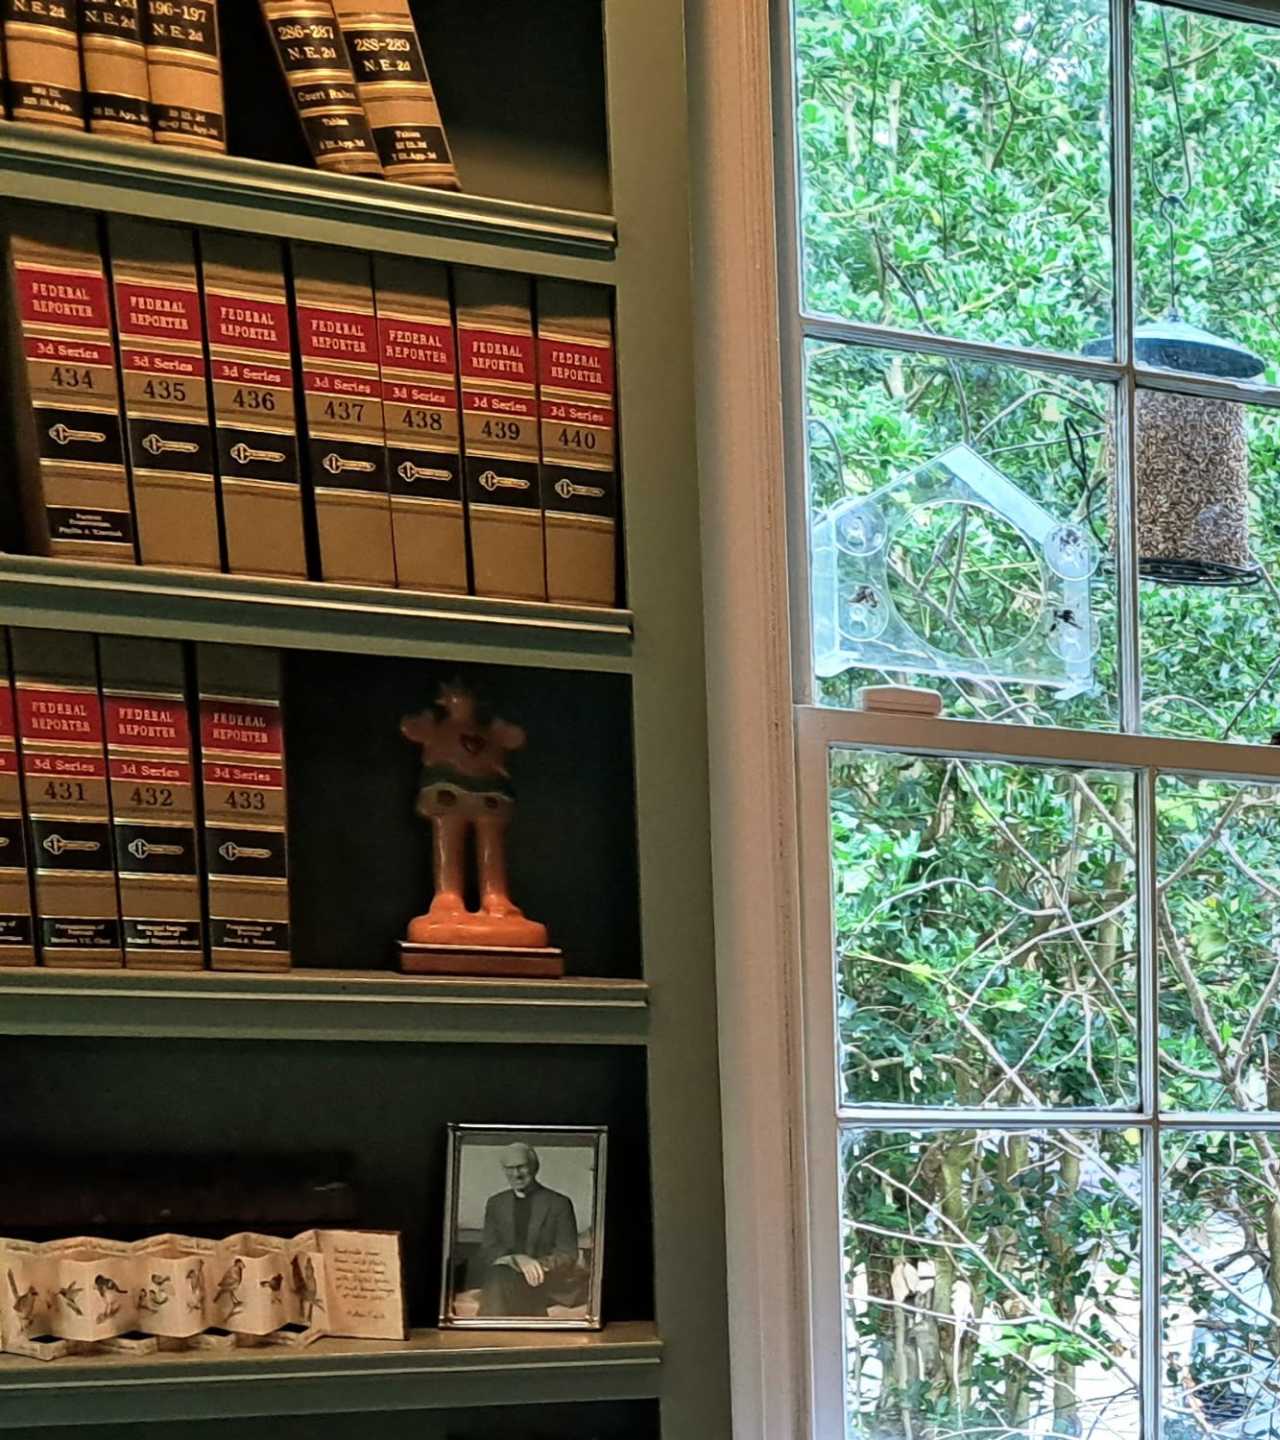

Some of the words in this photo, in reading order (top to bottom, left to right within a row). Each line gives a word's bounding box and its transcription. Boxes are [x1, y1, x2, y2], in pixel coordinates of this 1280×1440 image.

[103, 13, 119, 26] E.
[150, 2, 206, 22] 196-197
[152, 23, 167, 37] N.
[170, 26, 185, 39] E.
[303, 47, 320, 59] E.
[380, 59, 396, 71] E.
[32, 282, 91, 300] FEDERAL
[32, 299, 94, 317] REPORTER
[130, 296, 186, 313] FEDERAL
[130, 312, 189, 330] REPORTER
[220, 307, 274, 325] FEDERAL
[220, 323, 277, 342] REPORTER
[311, 319, 364, 337] FEDERAL
[311, 335, 367, 353] REPORTER
[389, 329, 442, 348] FEDERAL
[37, 342, 54, 355] 3d
[58, 345, 99, 359] Series
[386, 345, 447, 364] REPORTER
[472, 341, 523, 358] FEDERAL
[133, 356, 149, 367] 3d
[154, 359, 193, 372] Series
[472, 357, 525, 374] REPORTER
[552, 350, 601, 368] FEDERAL
[51, 367, 95, 389] 434
[222, 365, 239, 377] 3d
[242, 368, 281, 383] Series
[551, 366, 602, 384] REPORTER
[143, 380, 186, 401] 435
[314, 376, 329, 388] 3d
[334, 379, 371, 394] Series
[233, 389, 275, 411] 436
[392, 387, 407, 399] 3d
[412, 388, 446, 404] Series
[324, 401, 364, 422] 437
[473, 397, 488, 409] 3d
[492, 399, 527, 413] Series
[402, 409, 442, 431] 438
[551, 406, 566, 418] 3d
[569, 408, 604, 423] Series
[481, 419, 520, 441] 439
[558, 428, 596, 450] 440
[32, 701, 87, 716] FEDERAL
[119, 707, 173, 723] FEDERAL
[32, 717, 90, 732] REPORTER
[213, 712, 266, 727] FEDERAL
[119, 723, 176, 738] REPORTER
[213, 727, 268, 743] REPORTER
[33, 761, 50, 770] 3d
[55, 760, 95, 772] Series
[121, 764, 136, 775] 3d
[141, 766, 180, 777] Series
[214, 767, 229, 778] 3d
[234, 770, 271, 782] Series
[44, 781, 87, 801] 431
[130, 787, 173, 807] 432
[224, 789, 265, 810] 433
